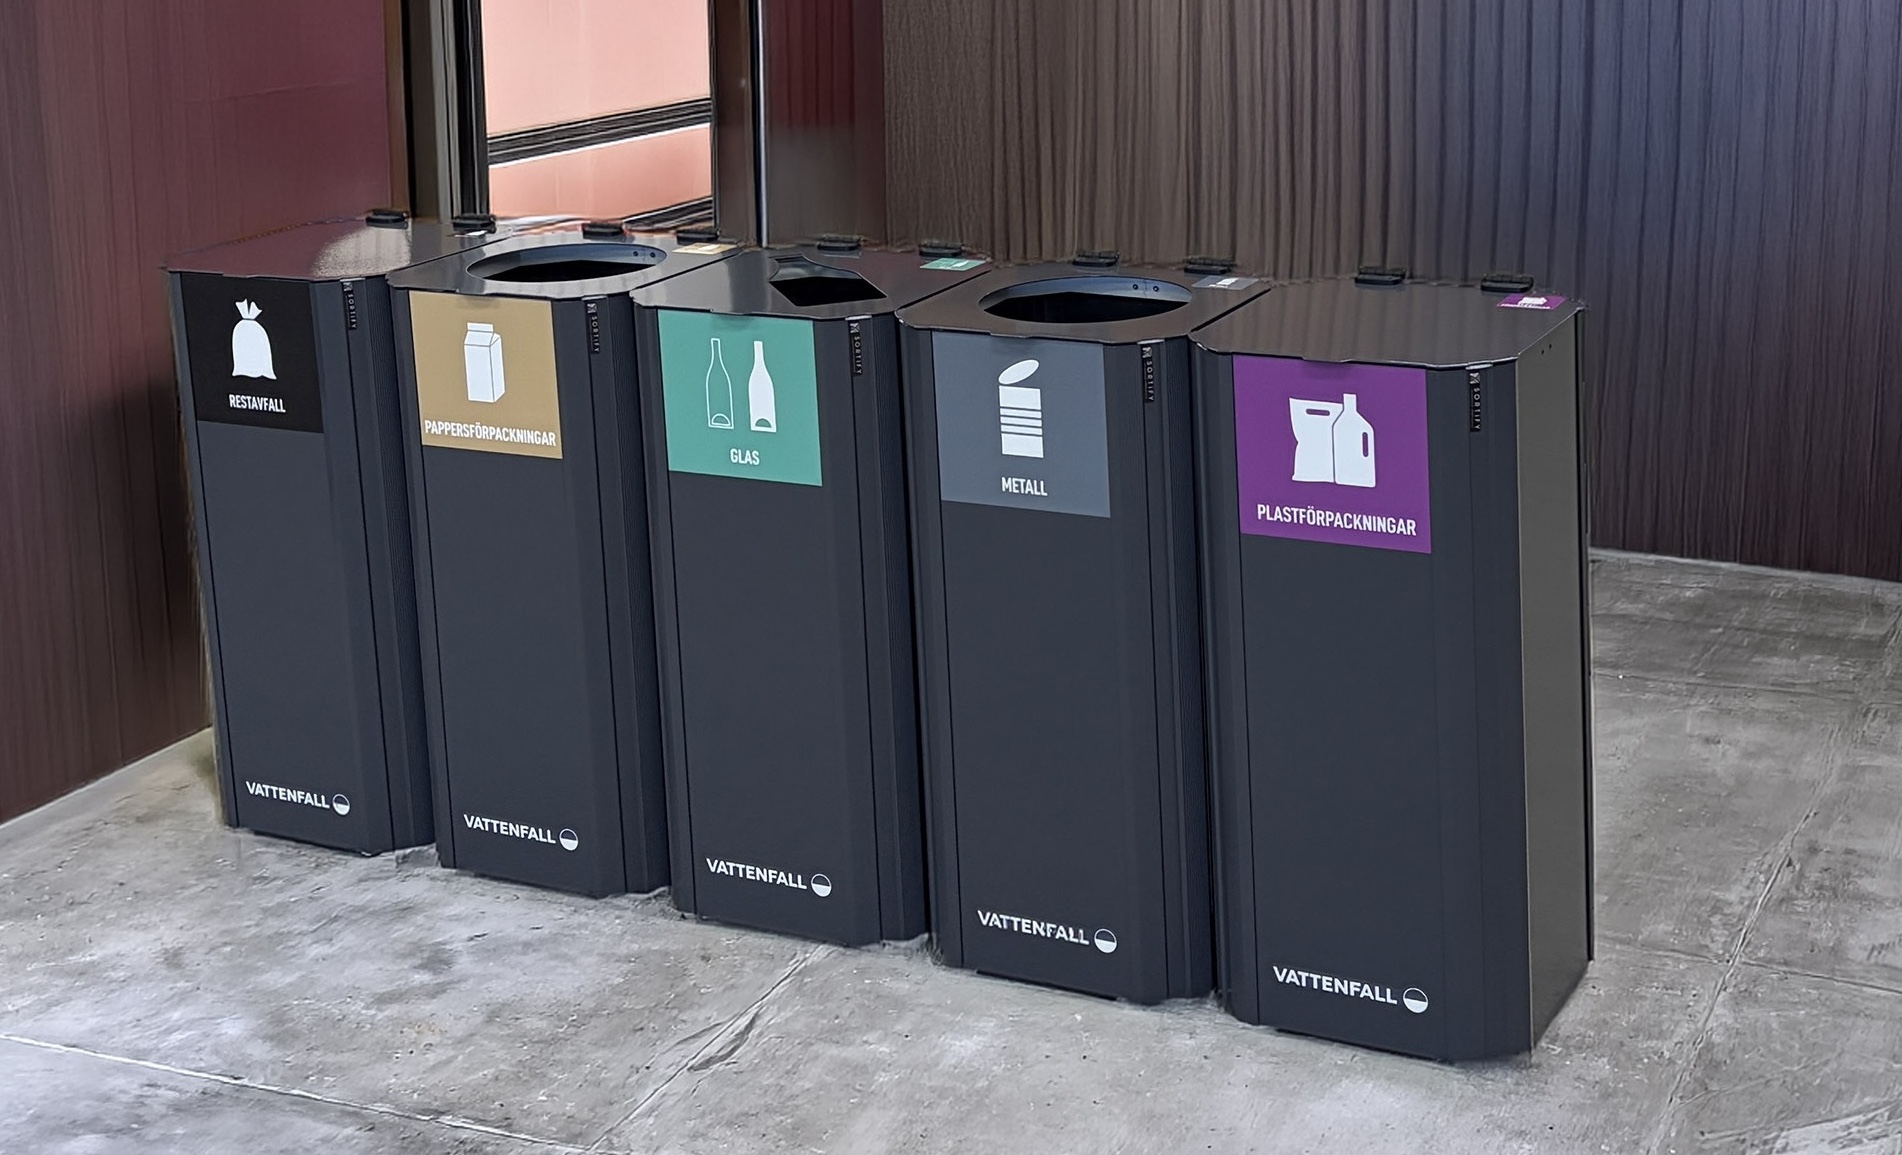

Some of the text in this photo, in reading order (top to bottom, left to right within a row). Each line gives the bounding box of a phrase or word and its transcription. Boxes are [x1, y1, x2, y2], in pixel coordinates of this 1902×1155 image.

[229, 394, 286, 413] RESTAVFALL
[424, 420, 556, 447] PAPPERSFÖRPACKNINGAR
[730, 448, 760, 466] GLAS
[1001, 477, 1048, 497] METALL
[1257, 504, 1417, 537] PLASTFÖRPACKNINGAR
[245, 781, 330, 809] VATTENFALL
[463, 814, 556, 844] VATTENFALL
[706, 857, 808, 890] VATTENFALL
[977, 910, 1090, 945] VATTENFALL
[1272, 966, 1398, 1006] VATTENFALL
